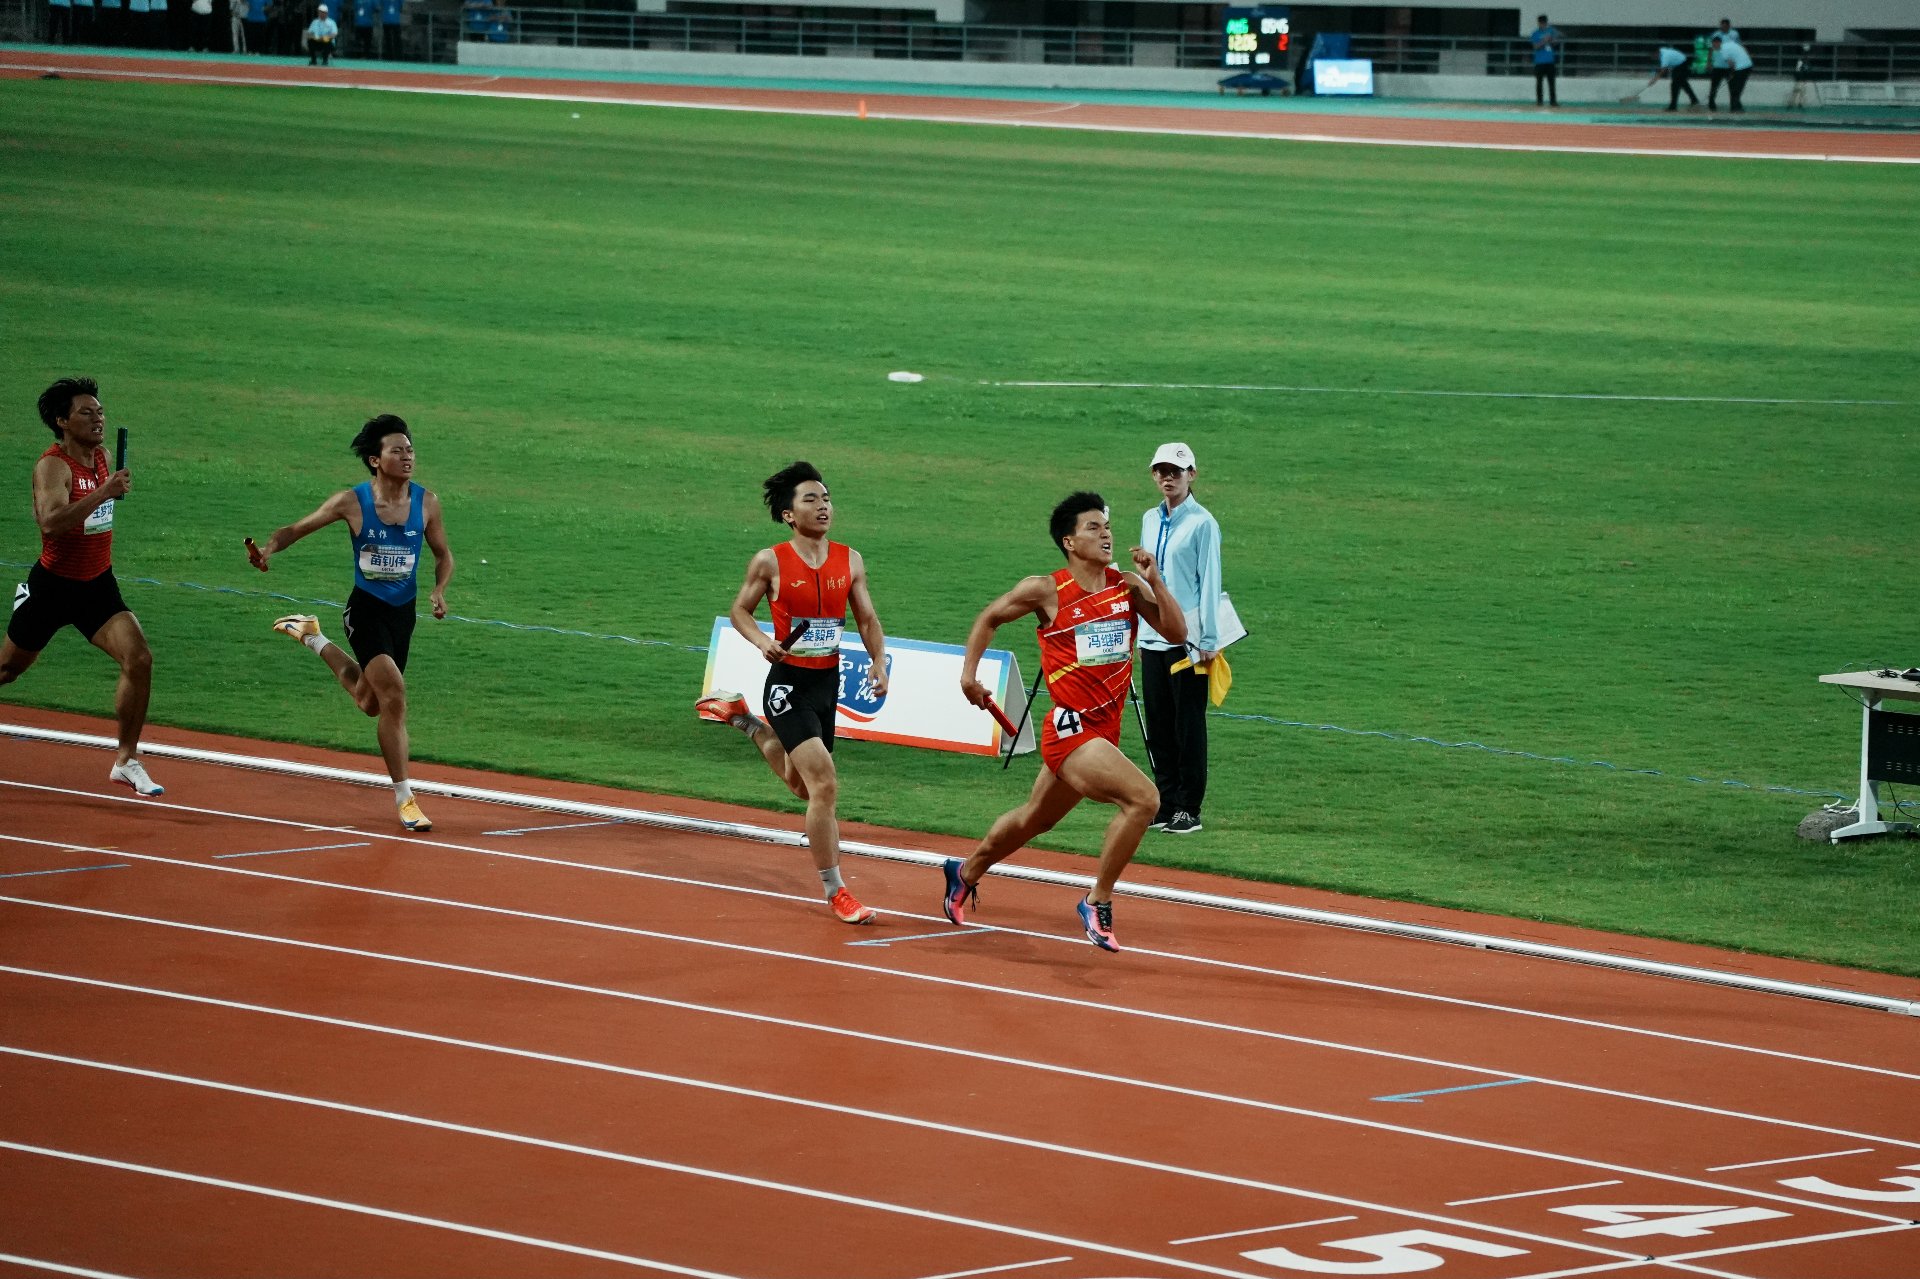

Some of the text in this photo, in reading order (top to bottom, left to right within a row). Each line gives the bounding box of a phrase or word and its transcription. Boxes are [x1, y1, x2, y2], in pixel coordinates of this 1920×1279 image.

[1057, 708, 1080, 734] 4
[1547, 1204, 1795, 1238] 4
[1239, 1229, 1531, 1275] 5
